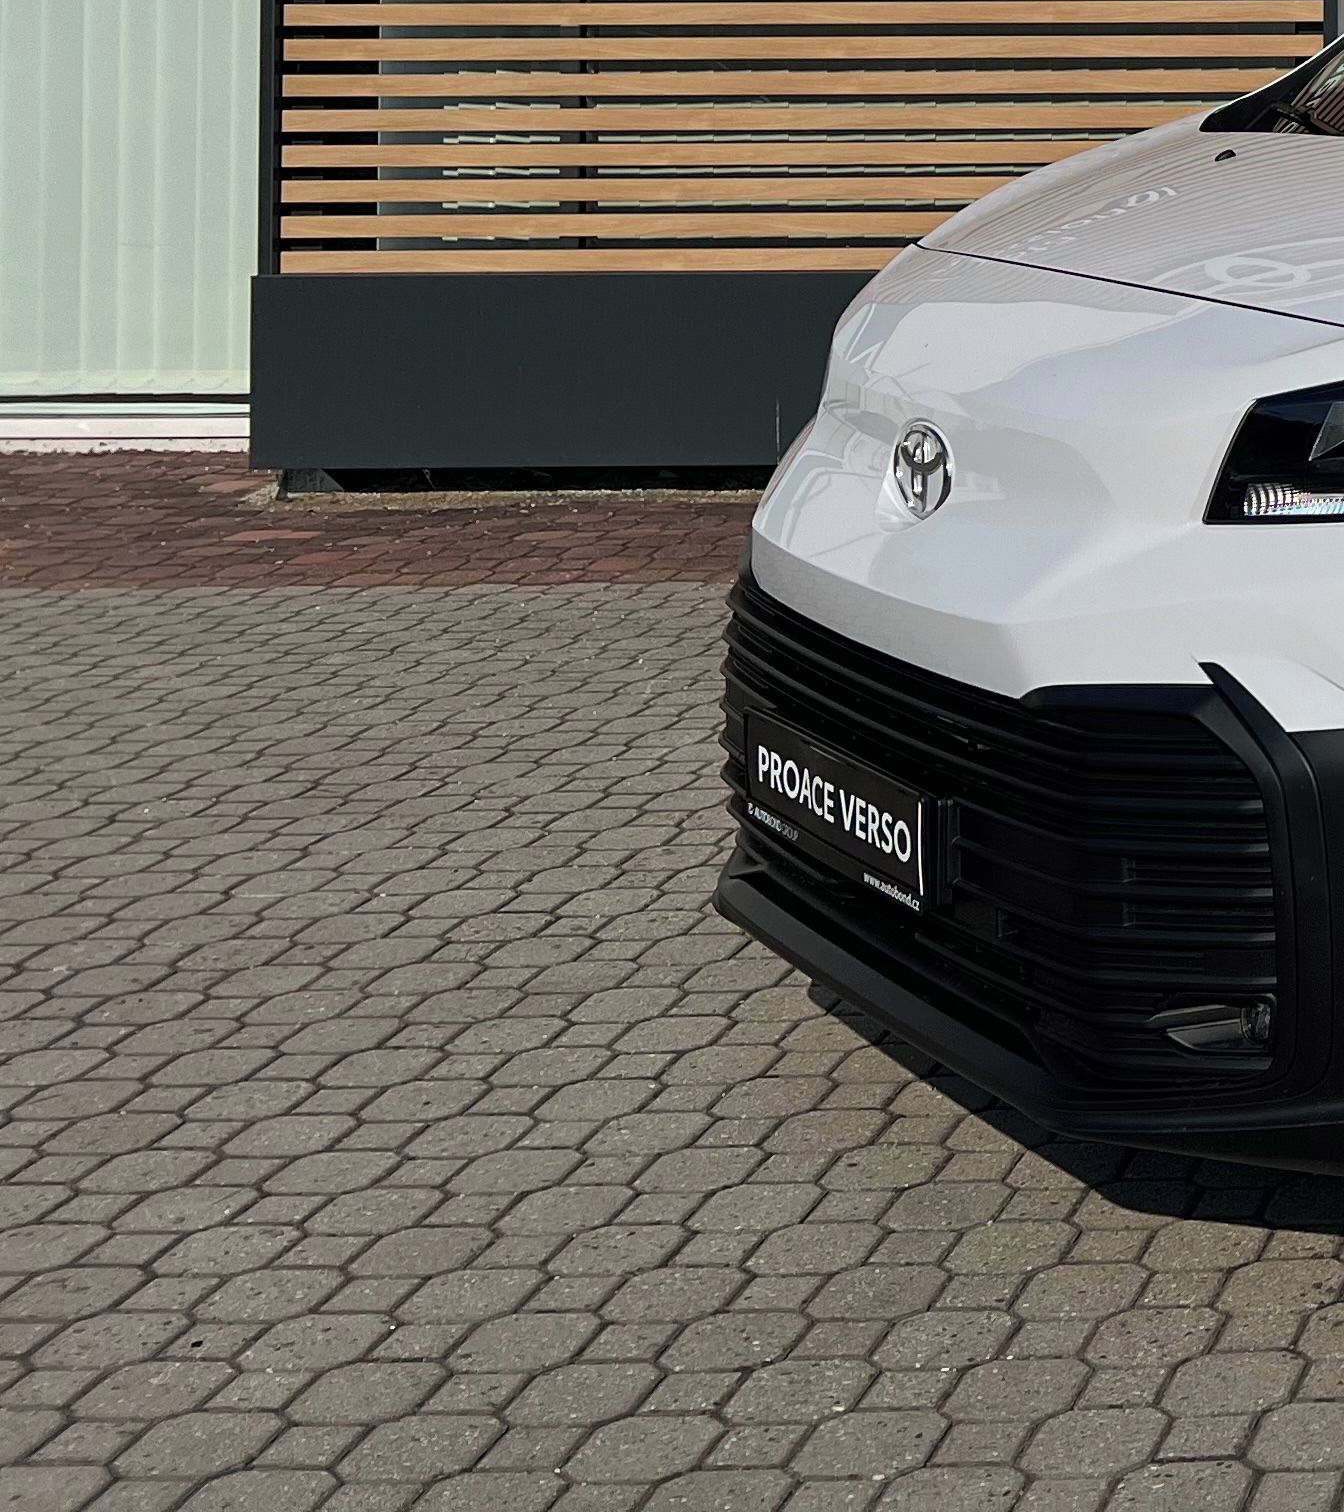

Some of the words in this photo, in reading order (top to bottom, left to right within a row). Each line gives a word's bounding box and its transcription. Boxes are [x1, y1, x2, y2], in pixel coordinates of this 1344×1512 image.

[758, 745, 835, 824] PROACE
[839, 789, 912, 863] VERSO
[863, 872, 920, 912] www.autobond.cz
